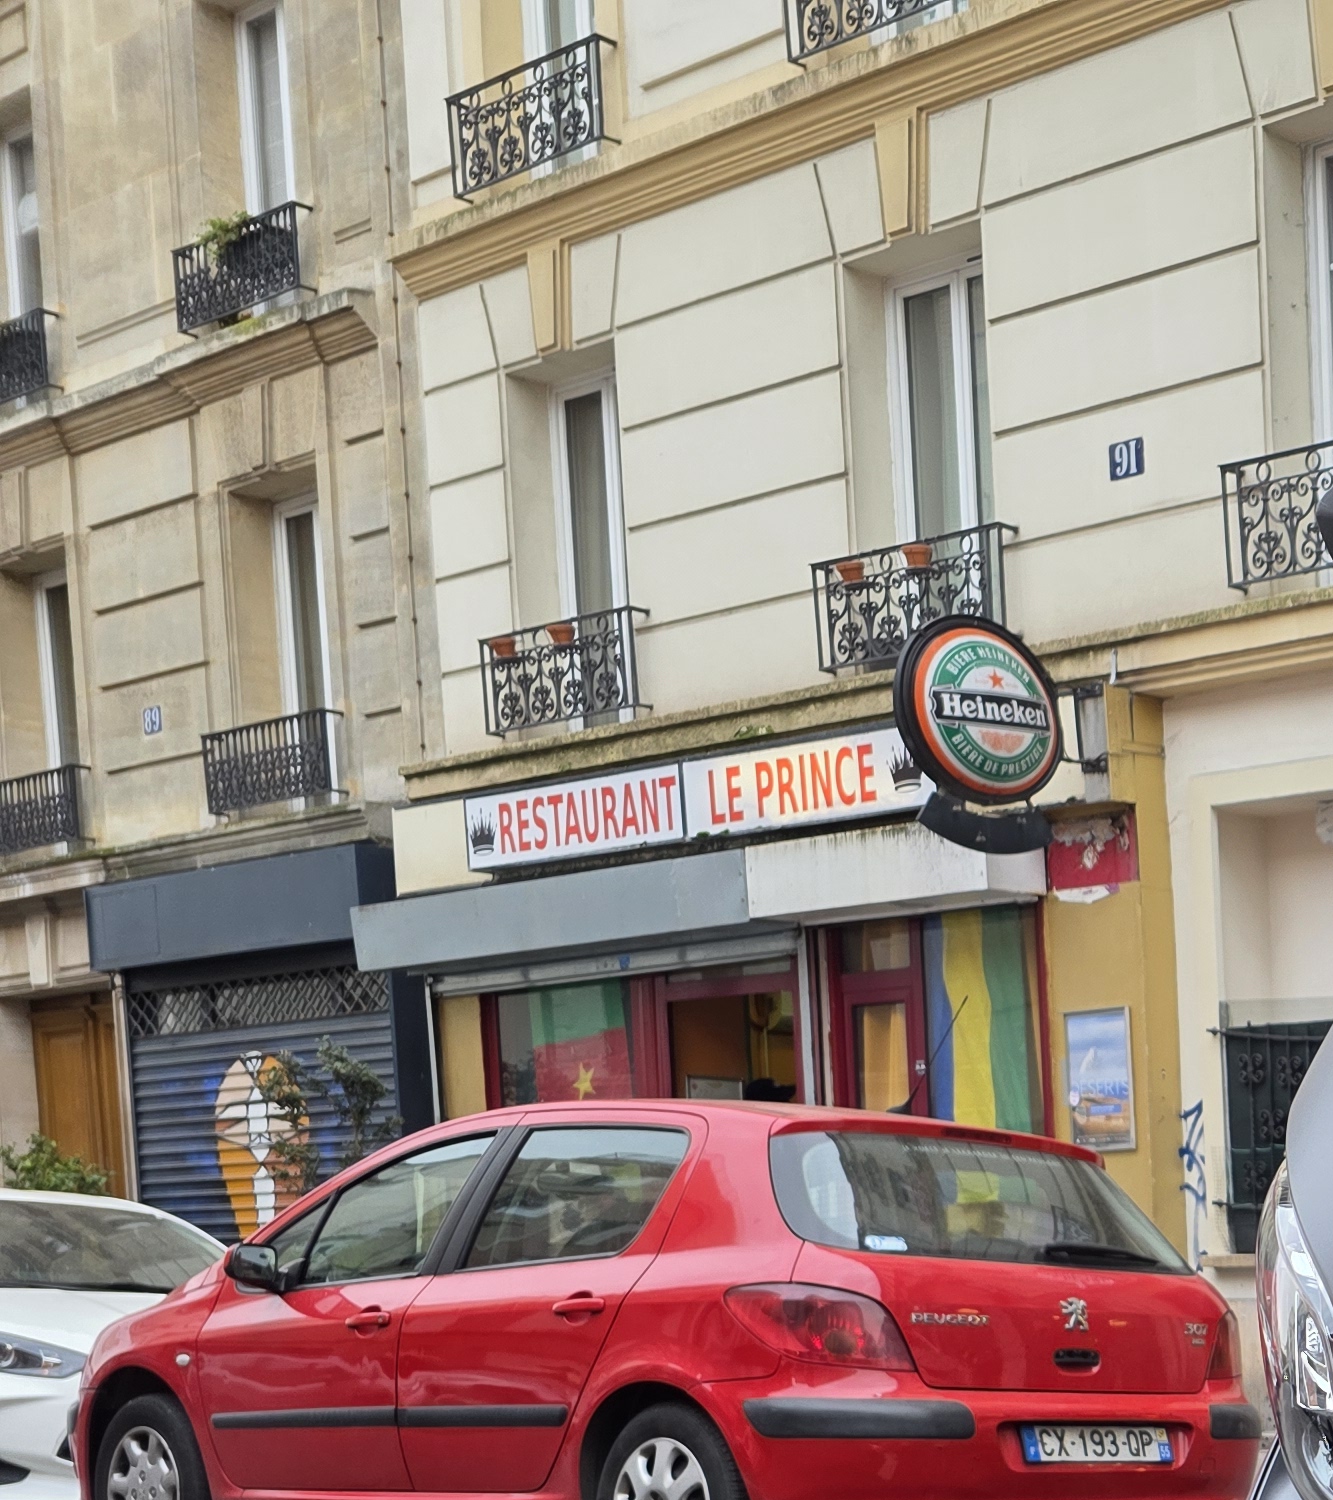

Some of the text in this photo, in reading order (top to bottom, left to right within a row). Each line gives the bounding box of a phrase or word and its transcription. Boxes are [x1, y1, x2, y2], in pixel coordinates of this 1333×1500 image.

[1114, 440, 1138, 476] 91
[976, 646, 1031, 684] HEINEKEN
[145, 707, 160, 732] 89
[941, 692, 1048, 728] Heineken
[952, 732, 1044, 776] BIERE DE PRESTIGE
[499, 744, 877, 854] RESTAURANT LE PRINCE
[910, 1311, 989, 1326] PEUGEOT
[1184, 1322, 1208, 1336] 307
[1038, 1428, 1153, 1458] CX-193-QP
[1160, 1445, 1171, 1459] 55
